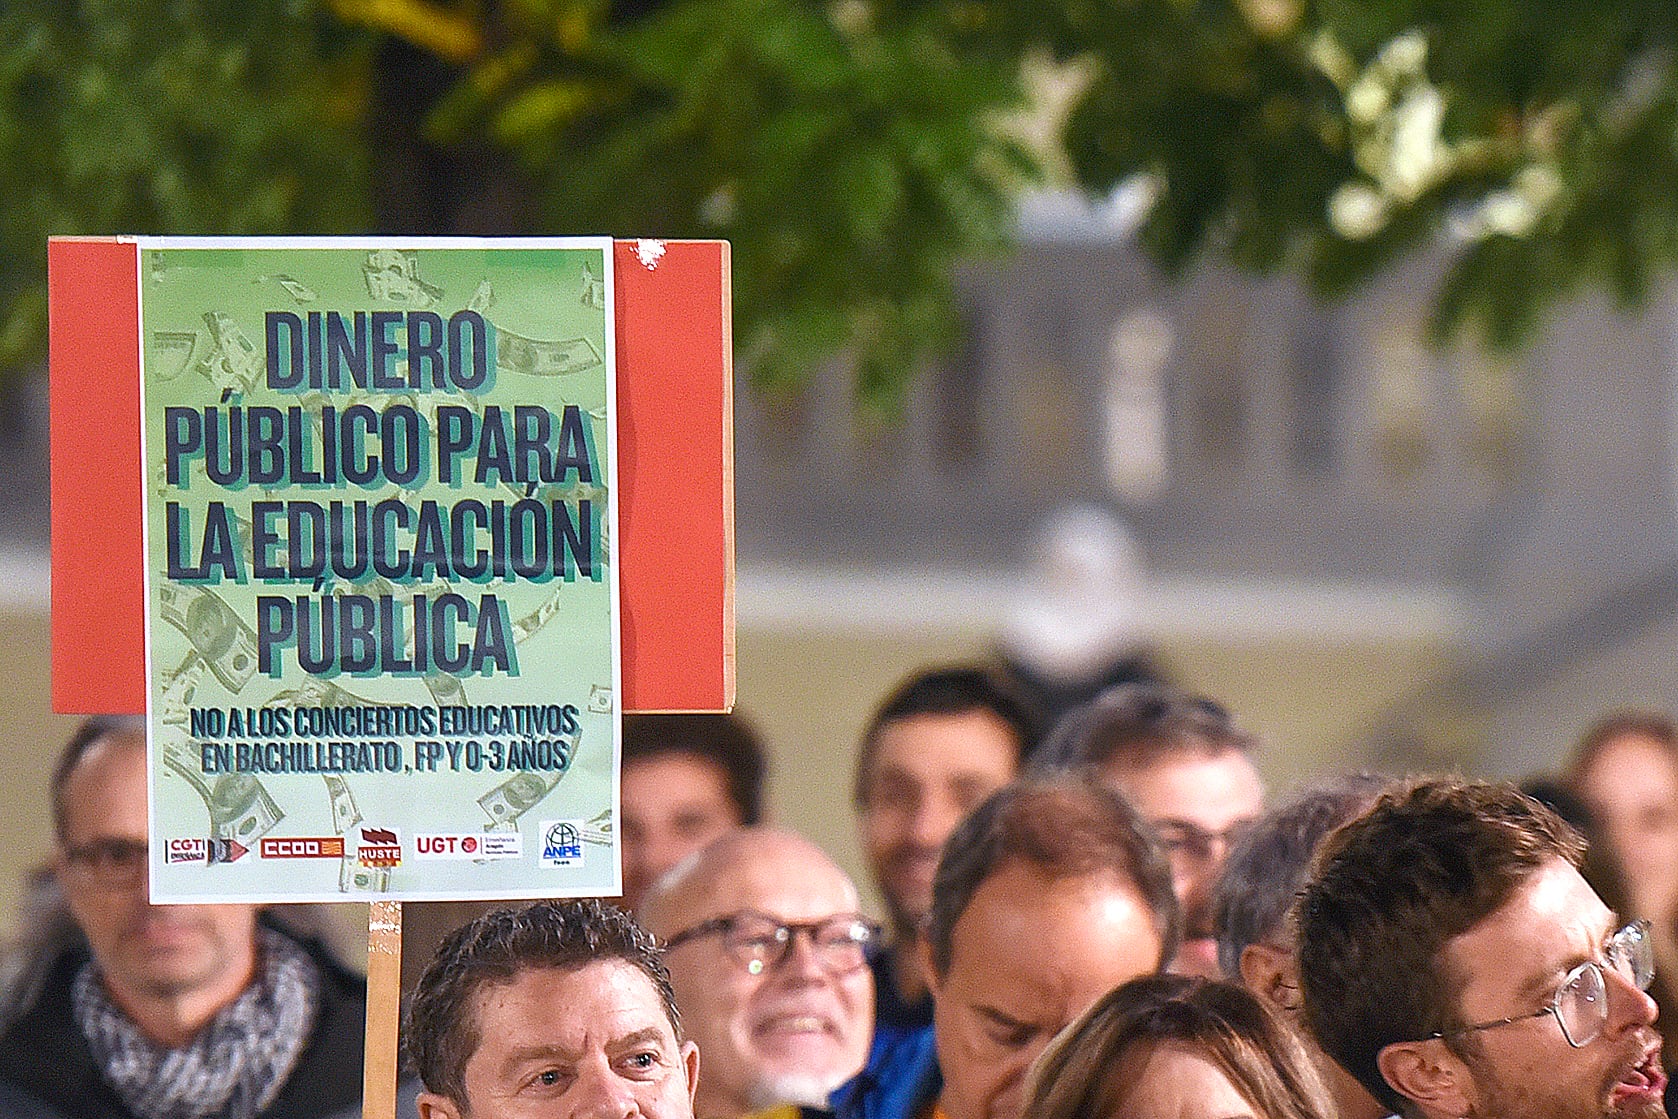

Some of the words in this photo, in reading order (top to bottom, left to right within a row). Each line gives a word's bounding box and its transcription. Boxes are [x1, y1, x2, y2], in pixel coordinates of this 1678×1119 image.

[264, 309, 494, 394] DINERO
[164, 389, 429, 489] PÚBLICO
[436, 403, 602, 488] PARA
[166, 500, 247, 584] LA
[253, 483, 601, 584] EDUCACIÓN
[257, 577, 519, 677] PÚBLICA
[190, 707, 225, 739] NO
[228, 707, 245, 738] A
[247, 706, 292, 738] LOS
[294, 705, 437, 738] CONCIERTOS
[439, 704, 580, 737] EDUCATIVOS
[201, 743, 234, 774] EN
[415, 741, 444, 772] FP
[446, 741, 462, 772] Y
[507, 734, 571, 772] AÑOS
[417, 837, 458, 853] UGT
[543, 845, 581, 858] ANPE
